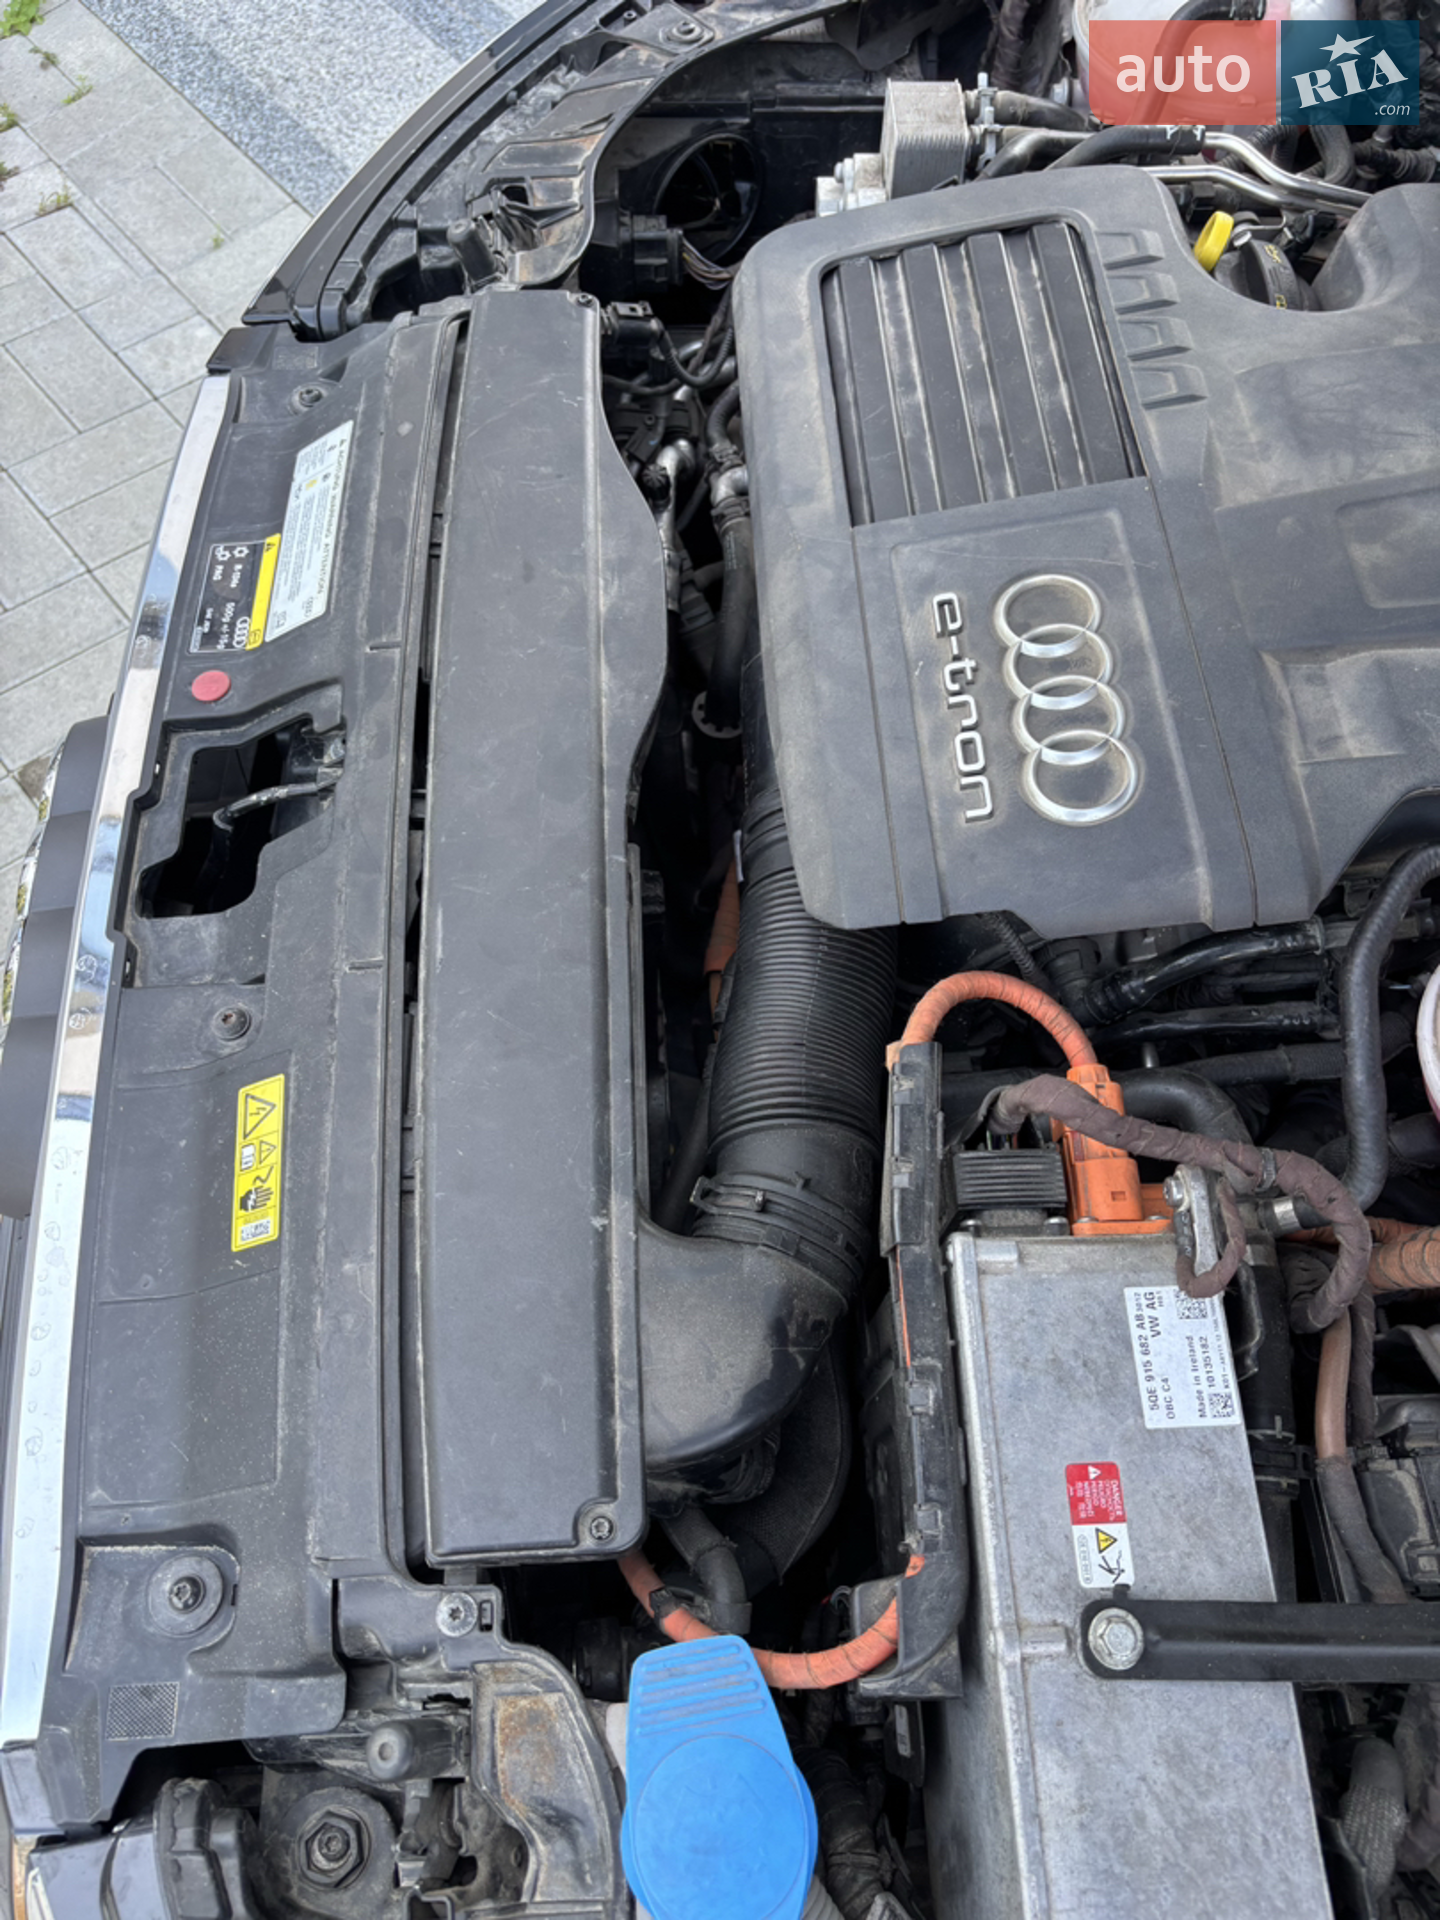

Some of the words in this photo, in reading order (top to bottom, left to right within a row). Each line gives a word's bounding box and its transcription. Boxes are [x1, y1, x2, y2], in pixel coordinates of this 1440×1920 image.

[318, 542, 331, 594] ATTENTION
[932, 591, 994, 822] e-tron
[1143, 1291, 1158, 1311] AG
[1134, 1313, 1147, 1330] AB
[1147, 1315, 1162, 1338] VW
[1138, 1334, 1151, 1356] 682
[1185, 1335, 1199, 1372] Ireland
[1143, 1360, 1156, 1382] 915
[1198, 1335, 1216, 1389] 10135182
[1161, 1377, 1171, 1392] C4
[1193, 1375, 1202, 1386] in
[1146, 1387, 1160, 1411] 5QE
[1164, 1396, 1176, 1420] OBC
[1196, 1390, 1207, 1418] Made
[1111, 1479, 1123, 1516] DANGER
